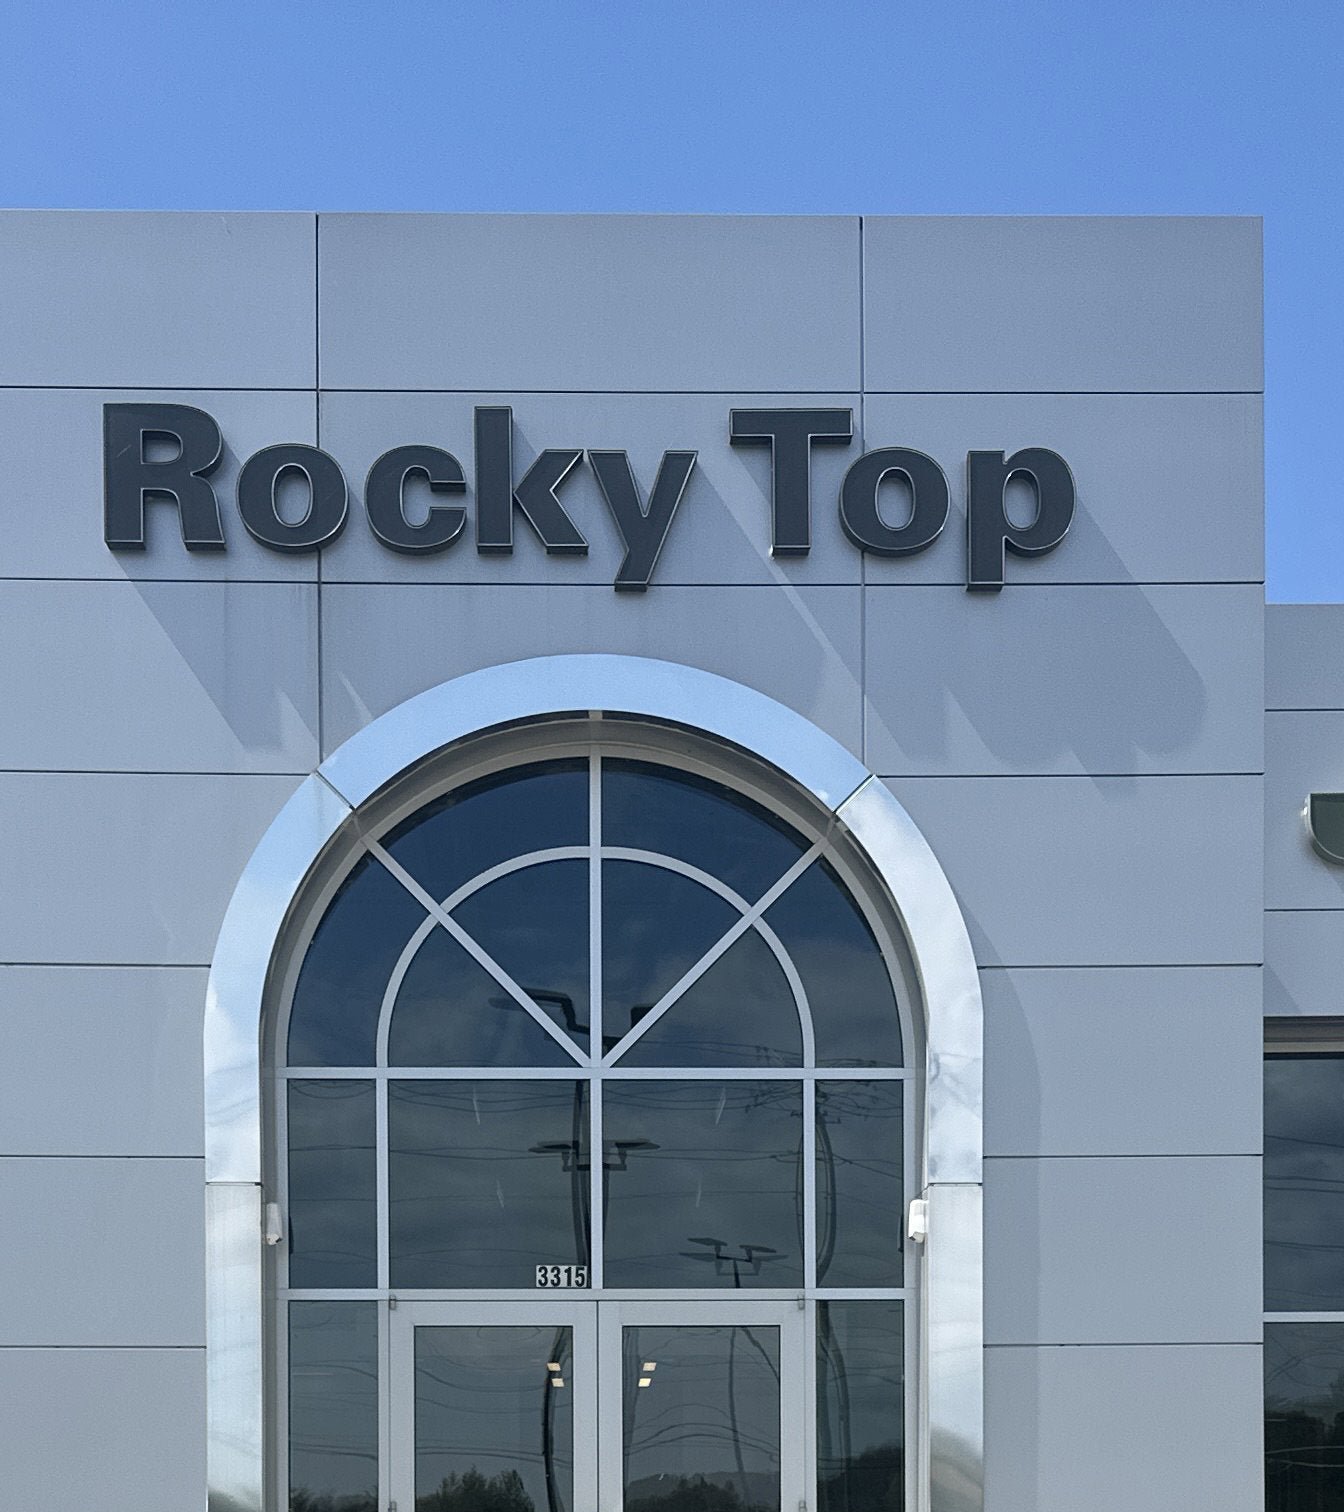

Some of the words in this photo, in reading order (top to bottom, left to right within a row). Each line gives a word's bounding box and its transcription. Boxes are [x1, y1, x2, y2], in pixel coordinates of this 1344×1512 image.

[102, 402, 699, 593] Rocky
[728, 407, 1078, 592] Top
[538, 1266, 586, 1288] 3315
